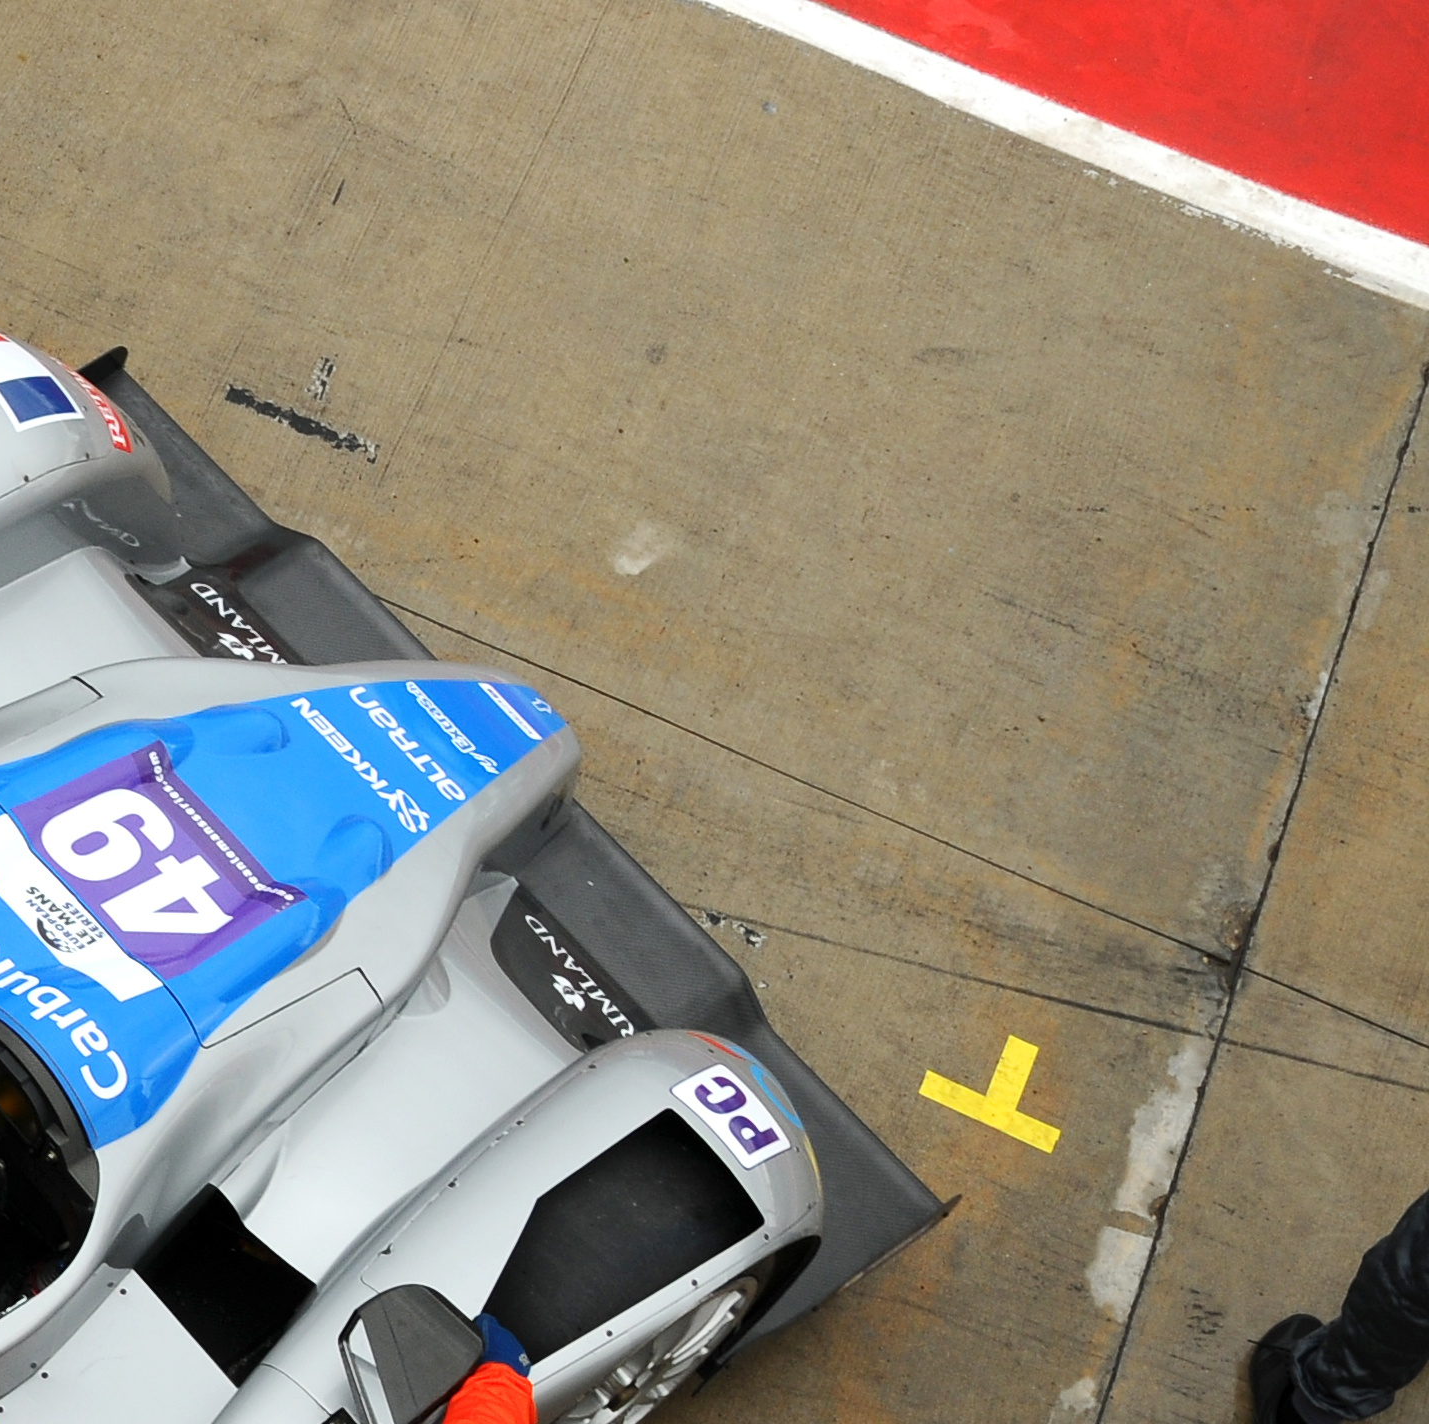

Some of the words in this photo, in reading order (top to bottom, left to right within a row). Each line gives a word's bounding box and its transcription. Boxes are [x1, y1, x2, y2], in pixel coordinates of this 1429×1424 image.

[290, 697, 431, 834] SYKKEEN
[41, 788, 234, 935] 49
[25, 886, 76, 927] MANS
[25, 899, 86, 951] EUROPEAN
[61, 902, 106, 940] SERIES
[77, 928, 97, 946] LE
[694, 1076, 780, 1155] PC
